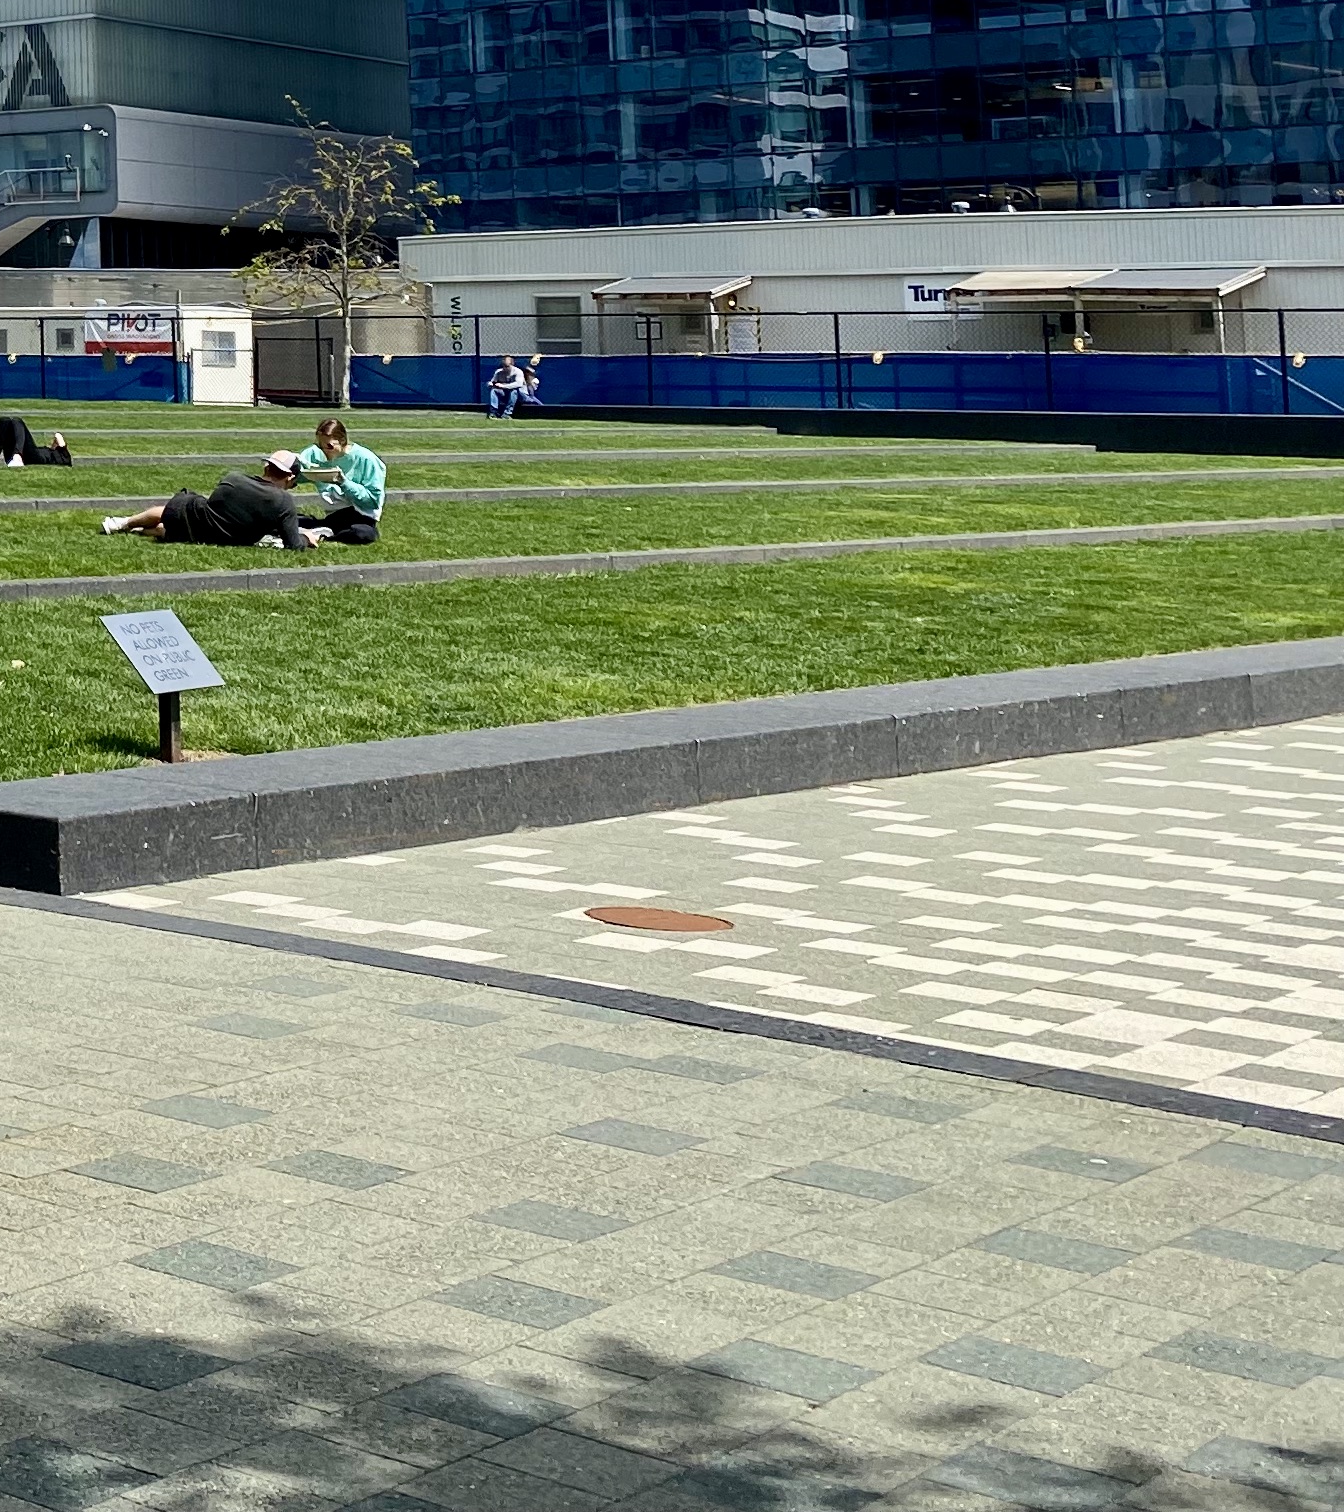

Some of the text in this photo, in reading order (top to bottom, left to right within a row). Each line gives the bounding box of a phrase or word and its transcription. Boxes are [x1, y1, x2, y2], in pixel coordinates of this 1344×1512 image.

[107, 313, 161, 332] PIVOT
[119, 620, 164, 636] NO PETS
[133, 636, 179, 650] ALLOWED
[142, 650, 195, 666] ON PUBLIC
[153, 668, 189, 681] GREEN
